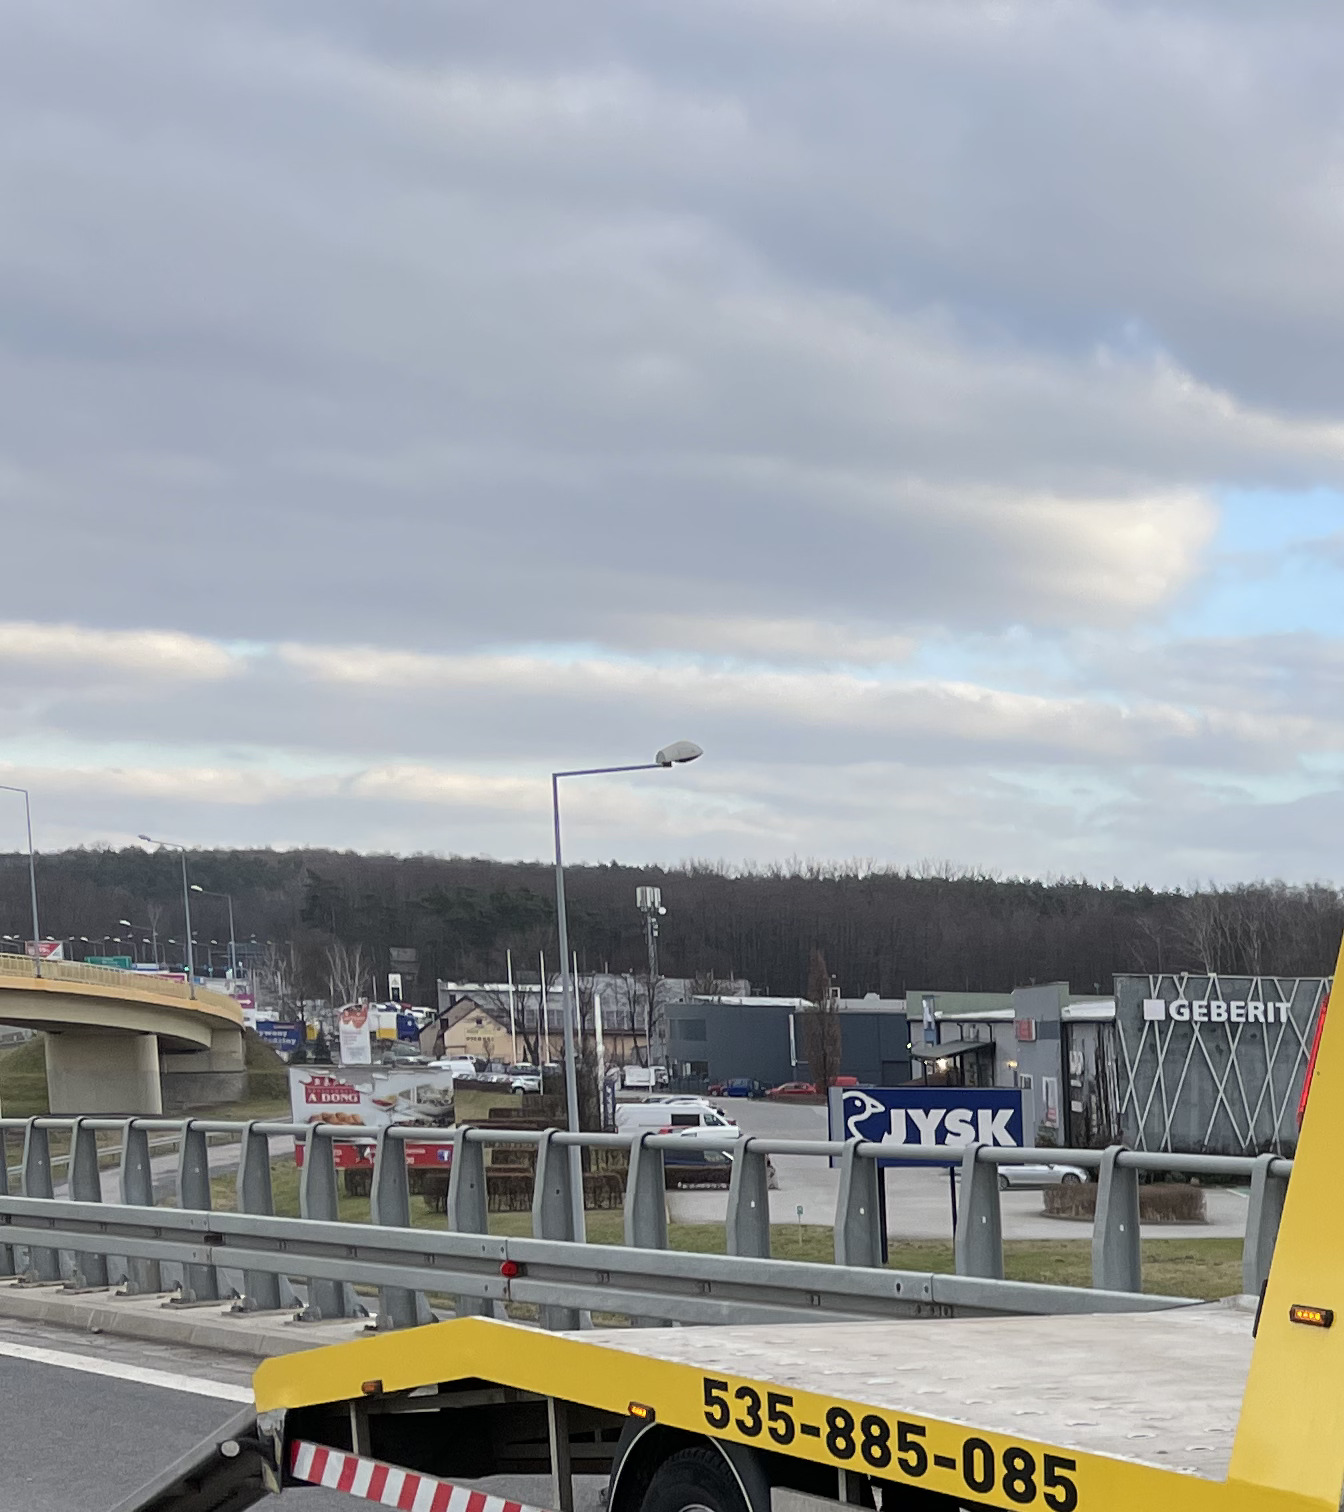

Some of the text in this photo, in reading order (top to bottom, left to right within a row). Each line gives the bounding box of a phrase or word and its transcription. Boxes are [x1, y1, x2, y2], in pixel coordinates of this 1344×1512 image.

[1168, 1000, 1292, 1024] GEBERIT
[321, 1094, 359, 1103] DONG
[881, 1108, 1017, 1147] JYSK
